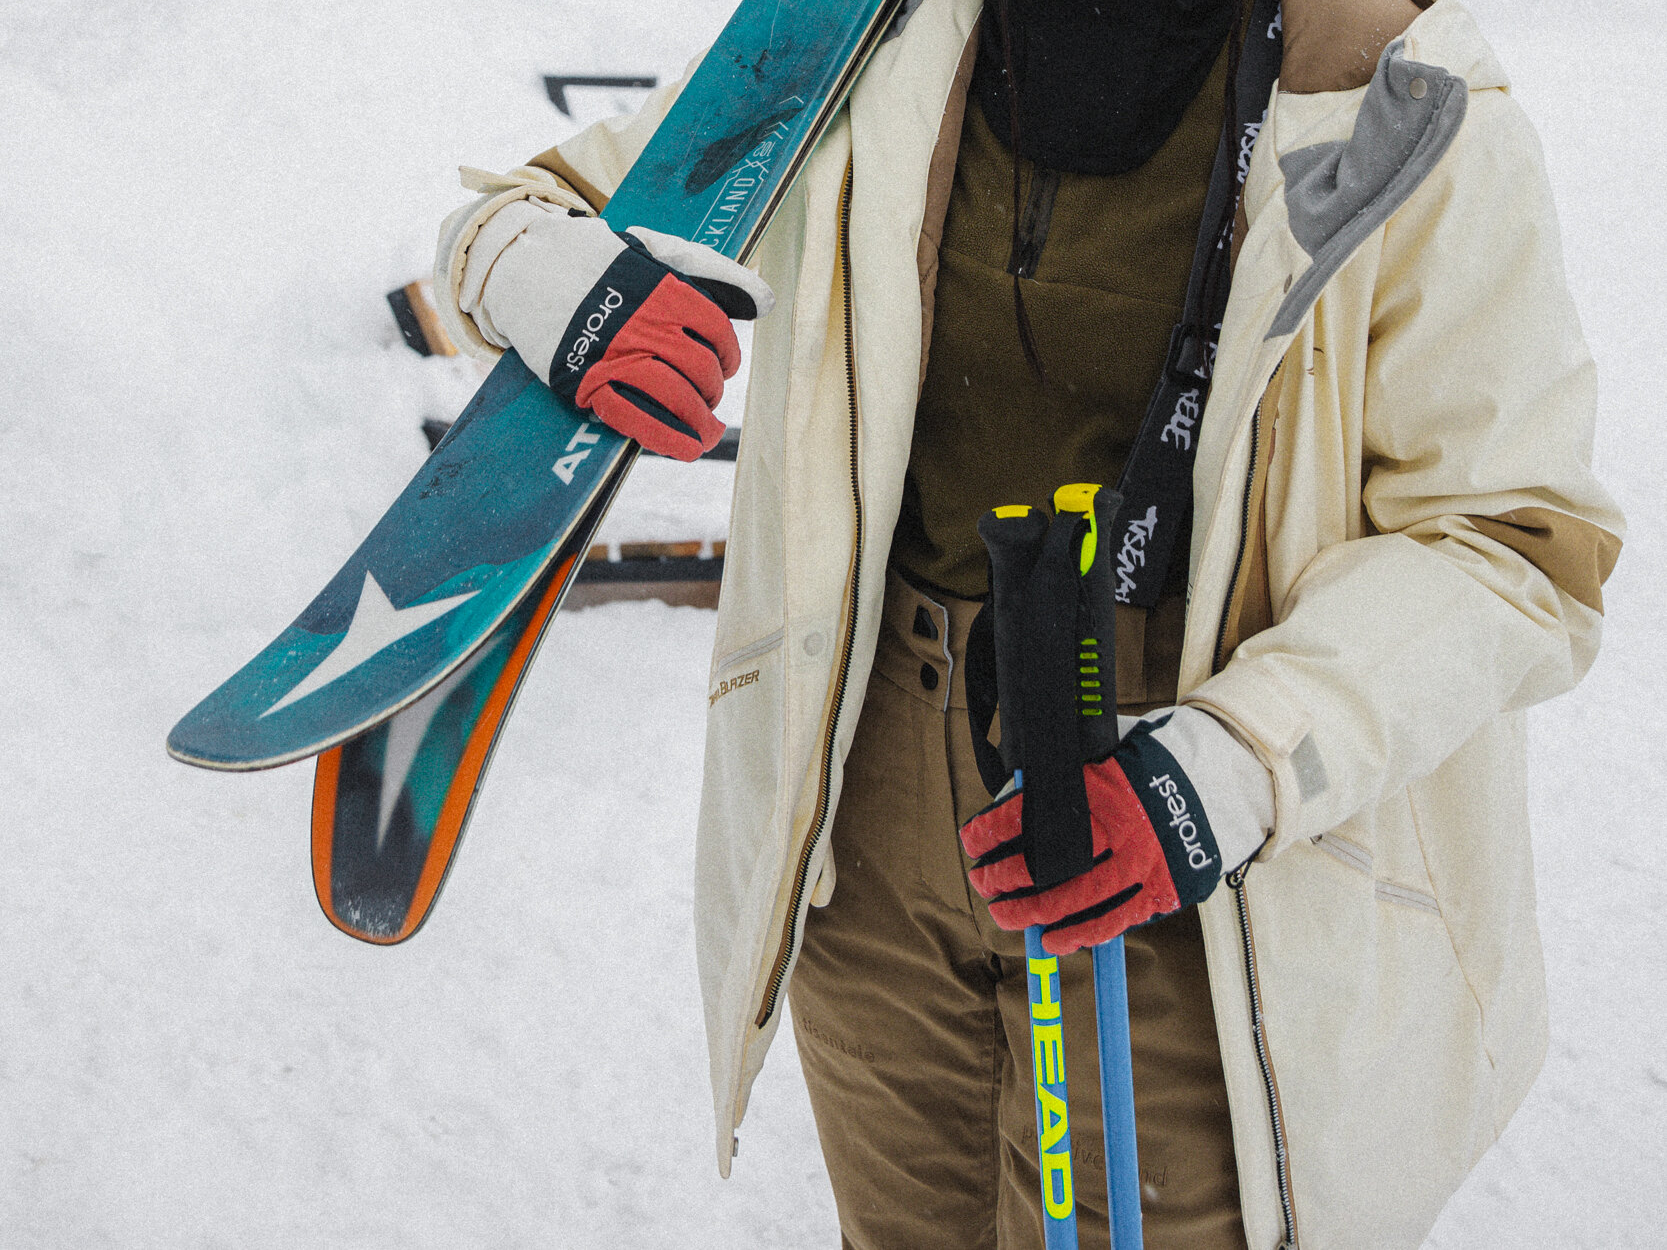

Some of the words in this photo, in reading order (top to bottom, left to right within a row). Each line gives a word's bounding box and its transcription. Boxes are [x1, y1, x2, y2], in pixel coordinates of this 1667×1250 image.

[566, 286, 624, 374] protest
[551, 418, 602, 486] AT
[1148, 772, 1214, 871] protest
[1028, 956, 1075, 1220] HEAD
